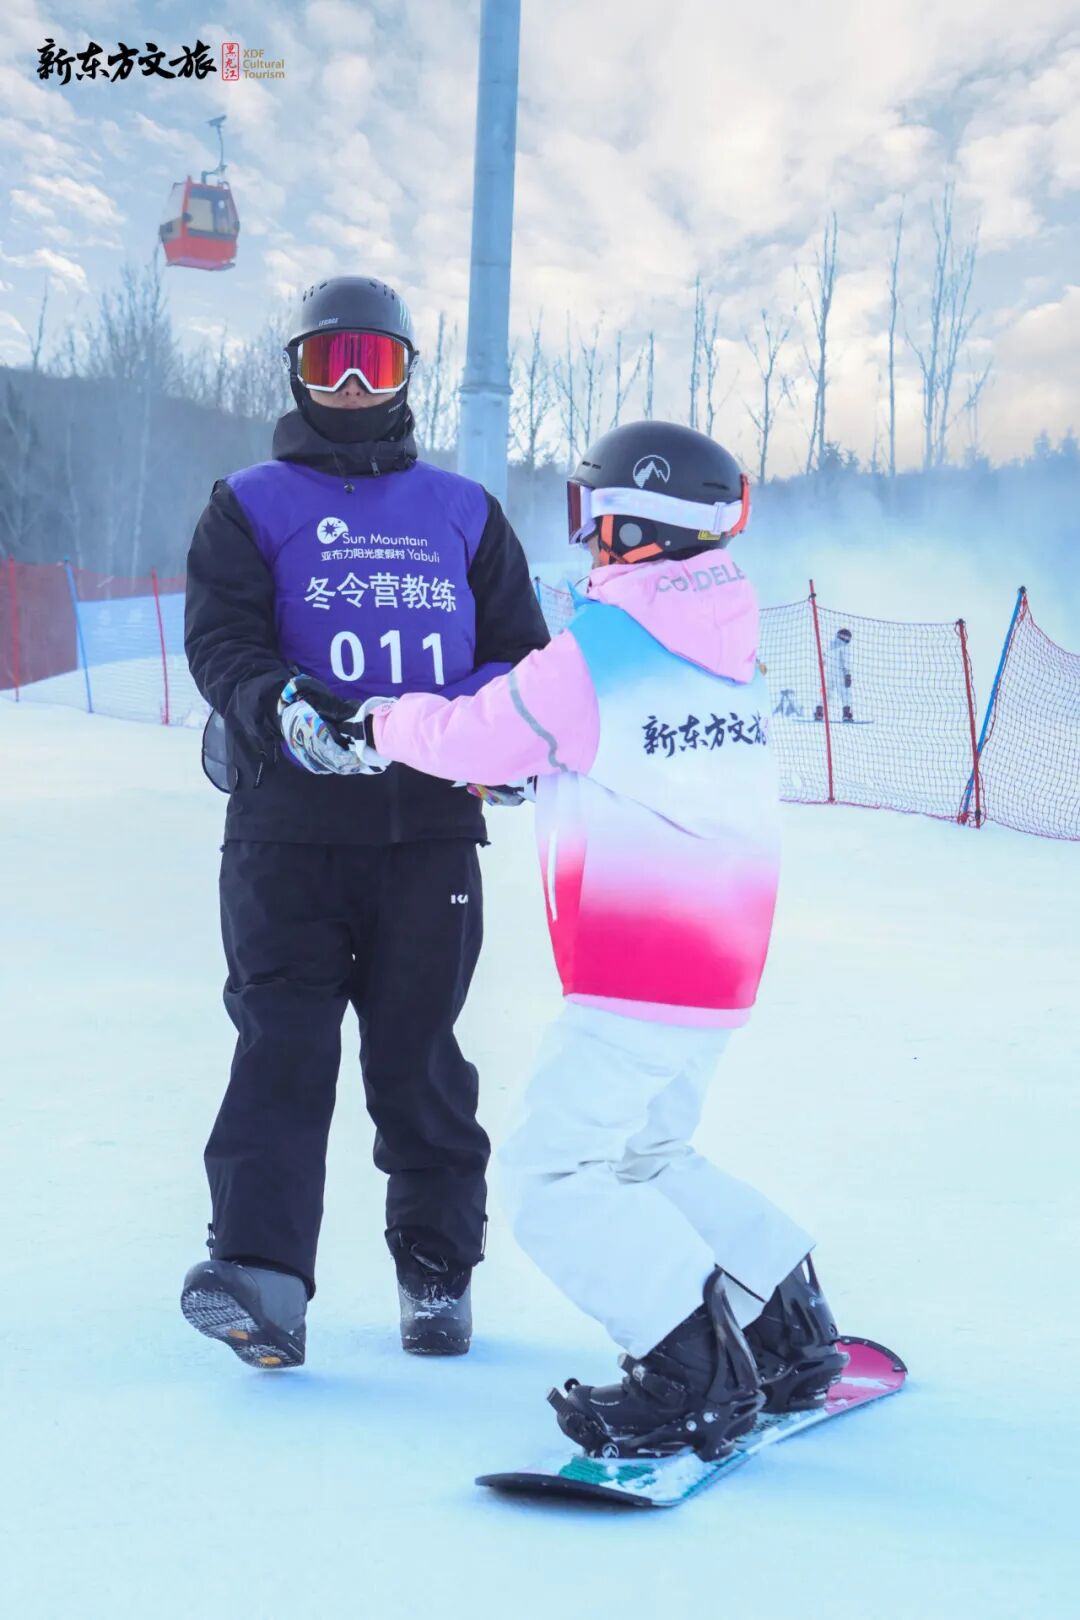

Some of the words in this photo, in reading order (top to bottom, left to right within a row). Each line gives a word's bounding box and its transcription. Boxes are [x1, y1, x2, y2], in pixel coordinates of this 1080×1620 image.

[342, 532, 366, 544] Sun
[370, 533, 428, 547] Mountain
[407, 549, 440, 563] Yabuli
[304, 572, 457, 612] 冬令营教练
[330, 630, 445, 686] 011
